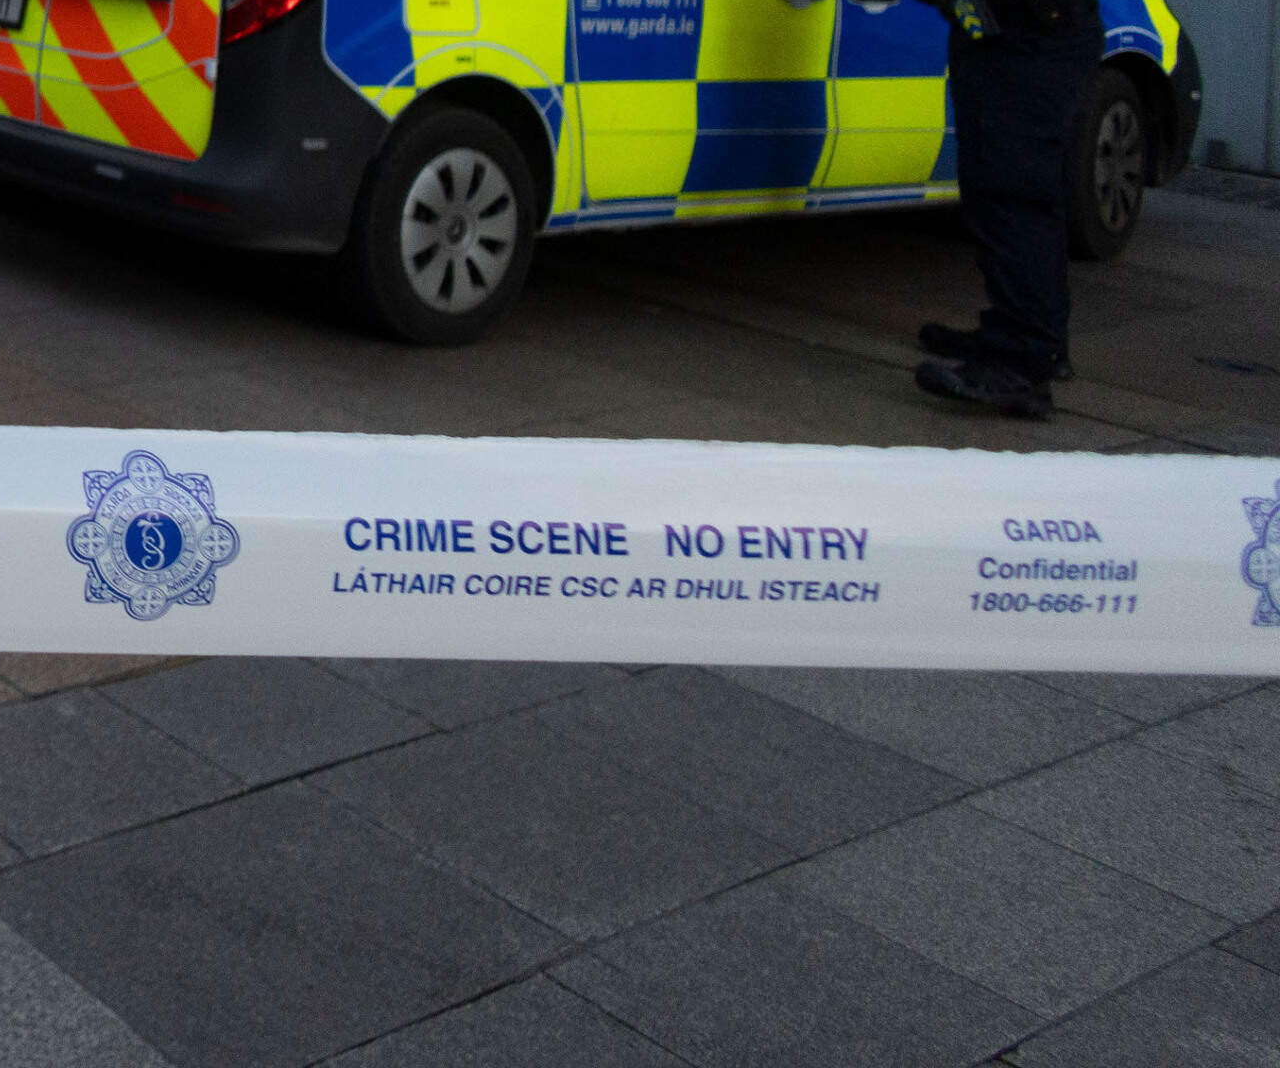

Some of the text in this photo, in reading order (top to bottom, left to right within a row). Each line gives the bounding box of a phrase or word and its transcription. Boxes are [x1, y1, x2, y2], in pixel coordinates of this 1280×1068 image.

[580, 13, 696, 40] www.garda.ie
[344, 517, 868, 562] CRIME SCENE NO ENTRY
[1003, 519, 1102, 543] GARDA
[978, 557, 1138, 581] Confidential
[333, 566, 880, 603] LÁTHAIR COIRE CSC AR DHUL ISTEACH
[970, 592, 1138, 613] 1800-666-111
